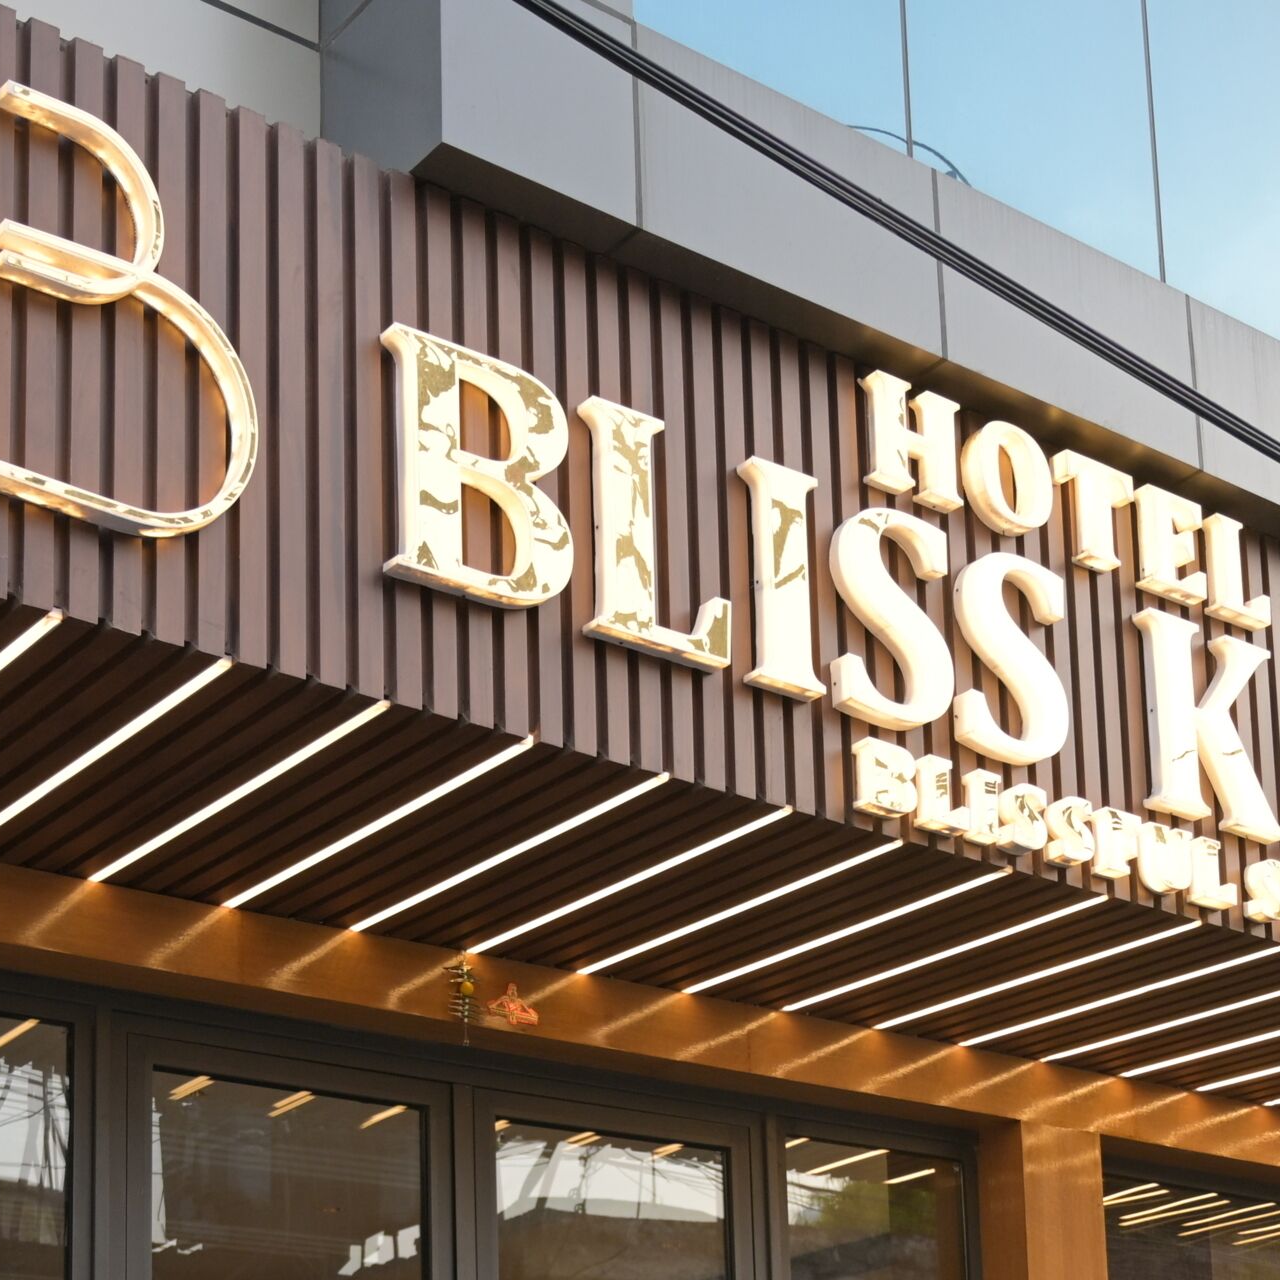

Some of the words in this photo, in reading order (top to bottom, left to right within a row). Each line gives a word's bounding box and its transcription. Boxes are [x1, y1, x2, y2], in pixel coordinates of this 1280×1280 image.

[379, 321, 1070, 767] BLISS
[857, 369, 1272, 632] HOTEL
[852, 736, 1238, 911] BLISSFUL
